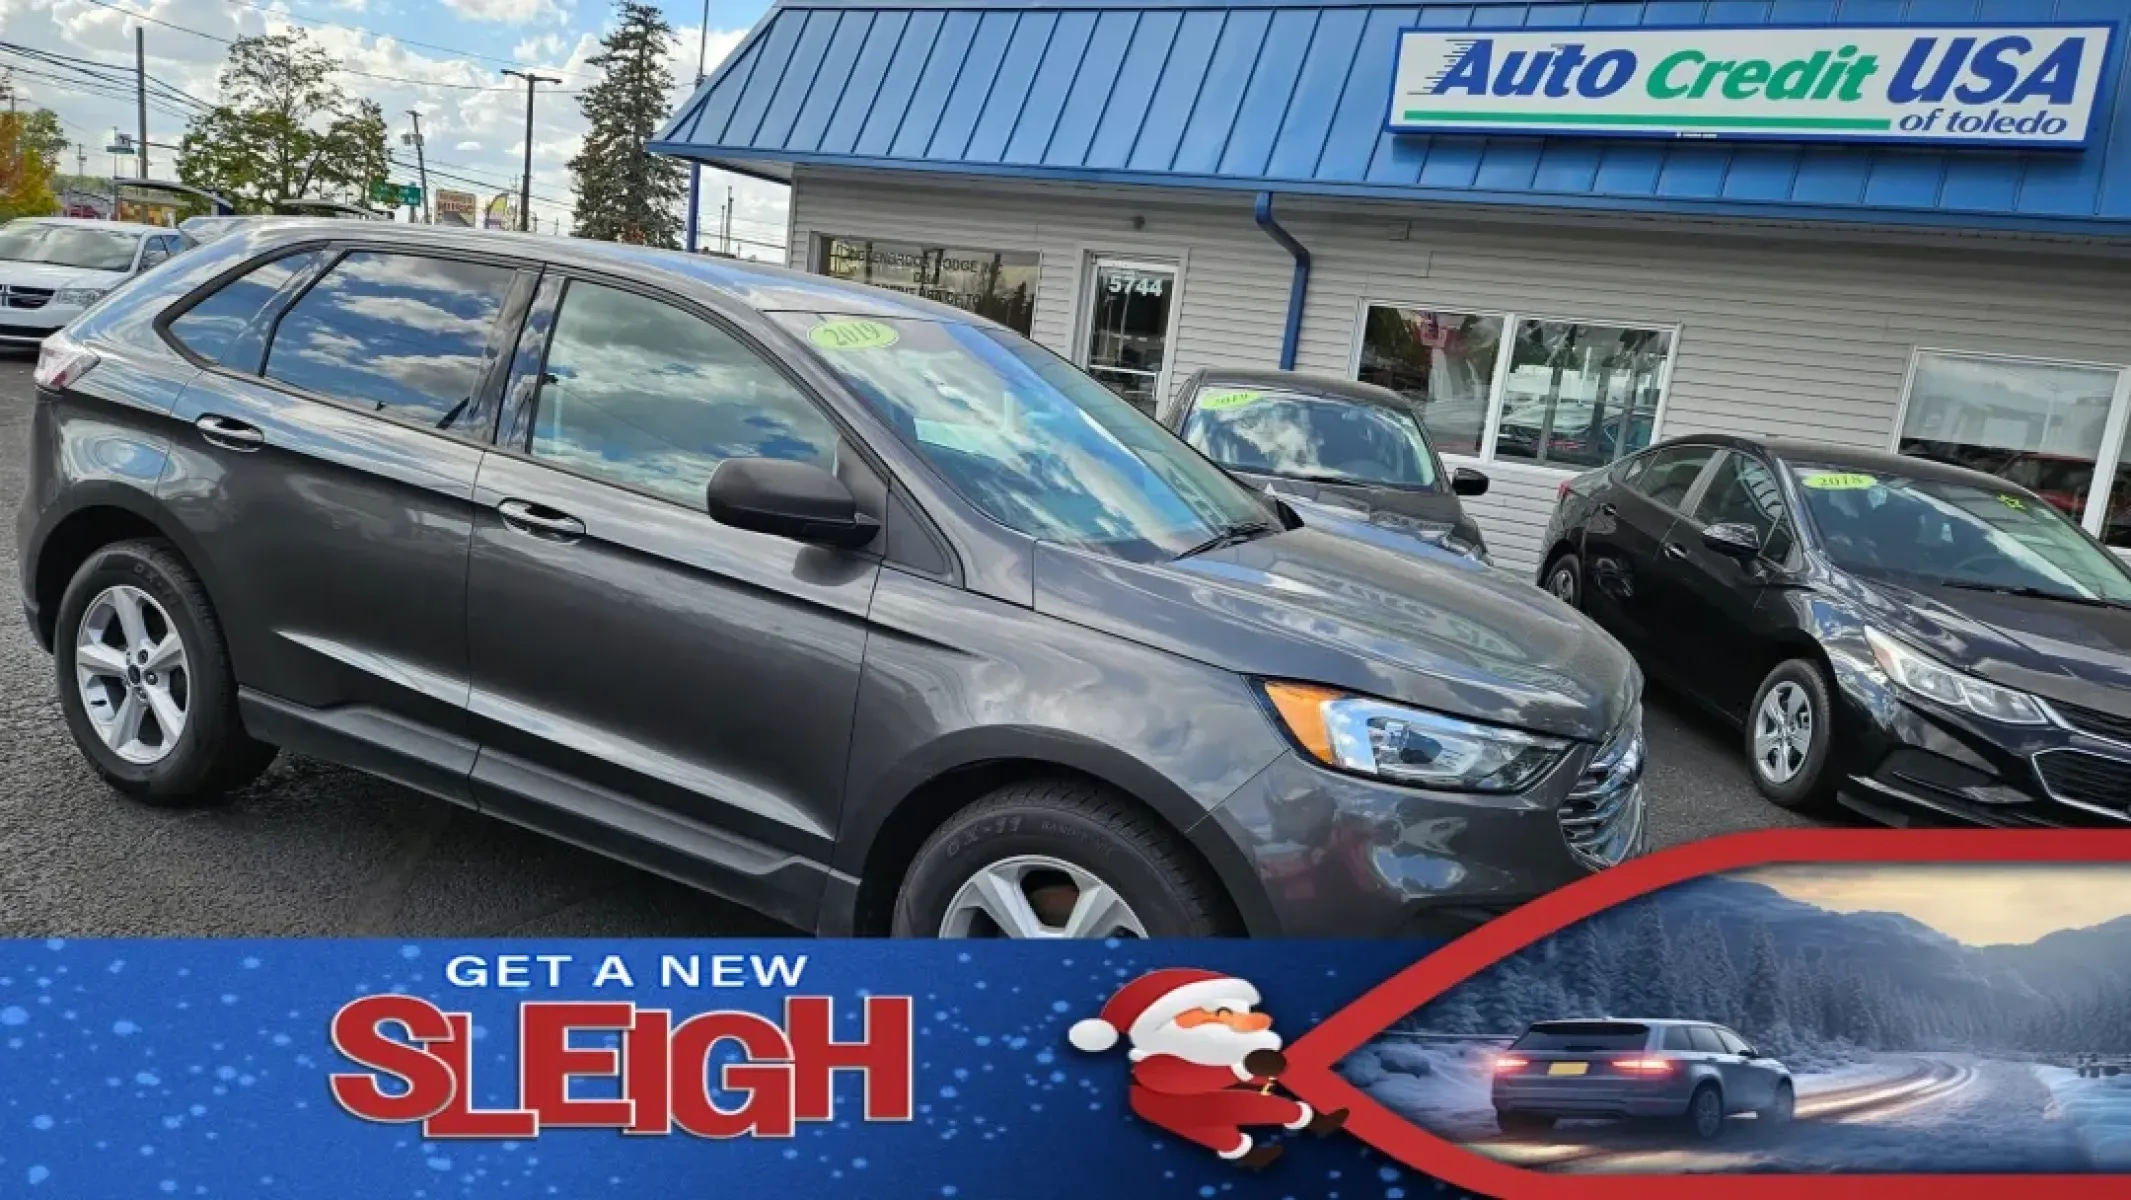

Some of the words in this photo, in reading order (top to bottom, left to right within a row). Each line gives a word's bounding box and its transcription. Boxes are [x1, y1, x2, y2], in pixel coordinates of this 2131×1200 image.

[1425, 38, 1638, 98] Auto
[1646, 44, 1879, 102] Credit
[1887, 35, 2086, 105] USA
[1898, 108, 1944, 132] of
[1946, 108, 2068, 135] toledo
[1108, 275, 1163, 297] 5744
[823, 322, 881, 346] 2019
